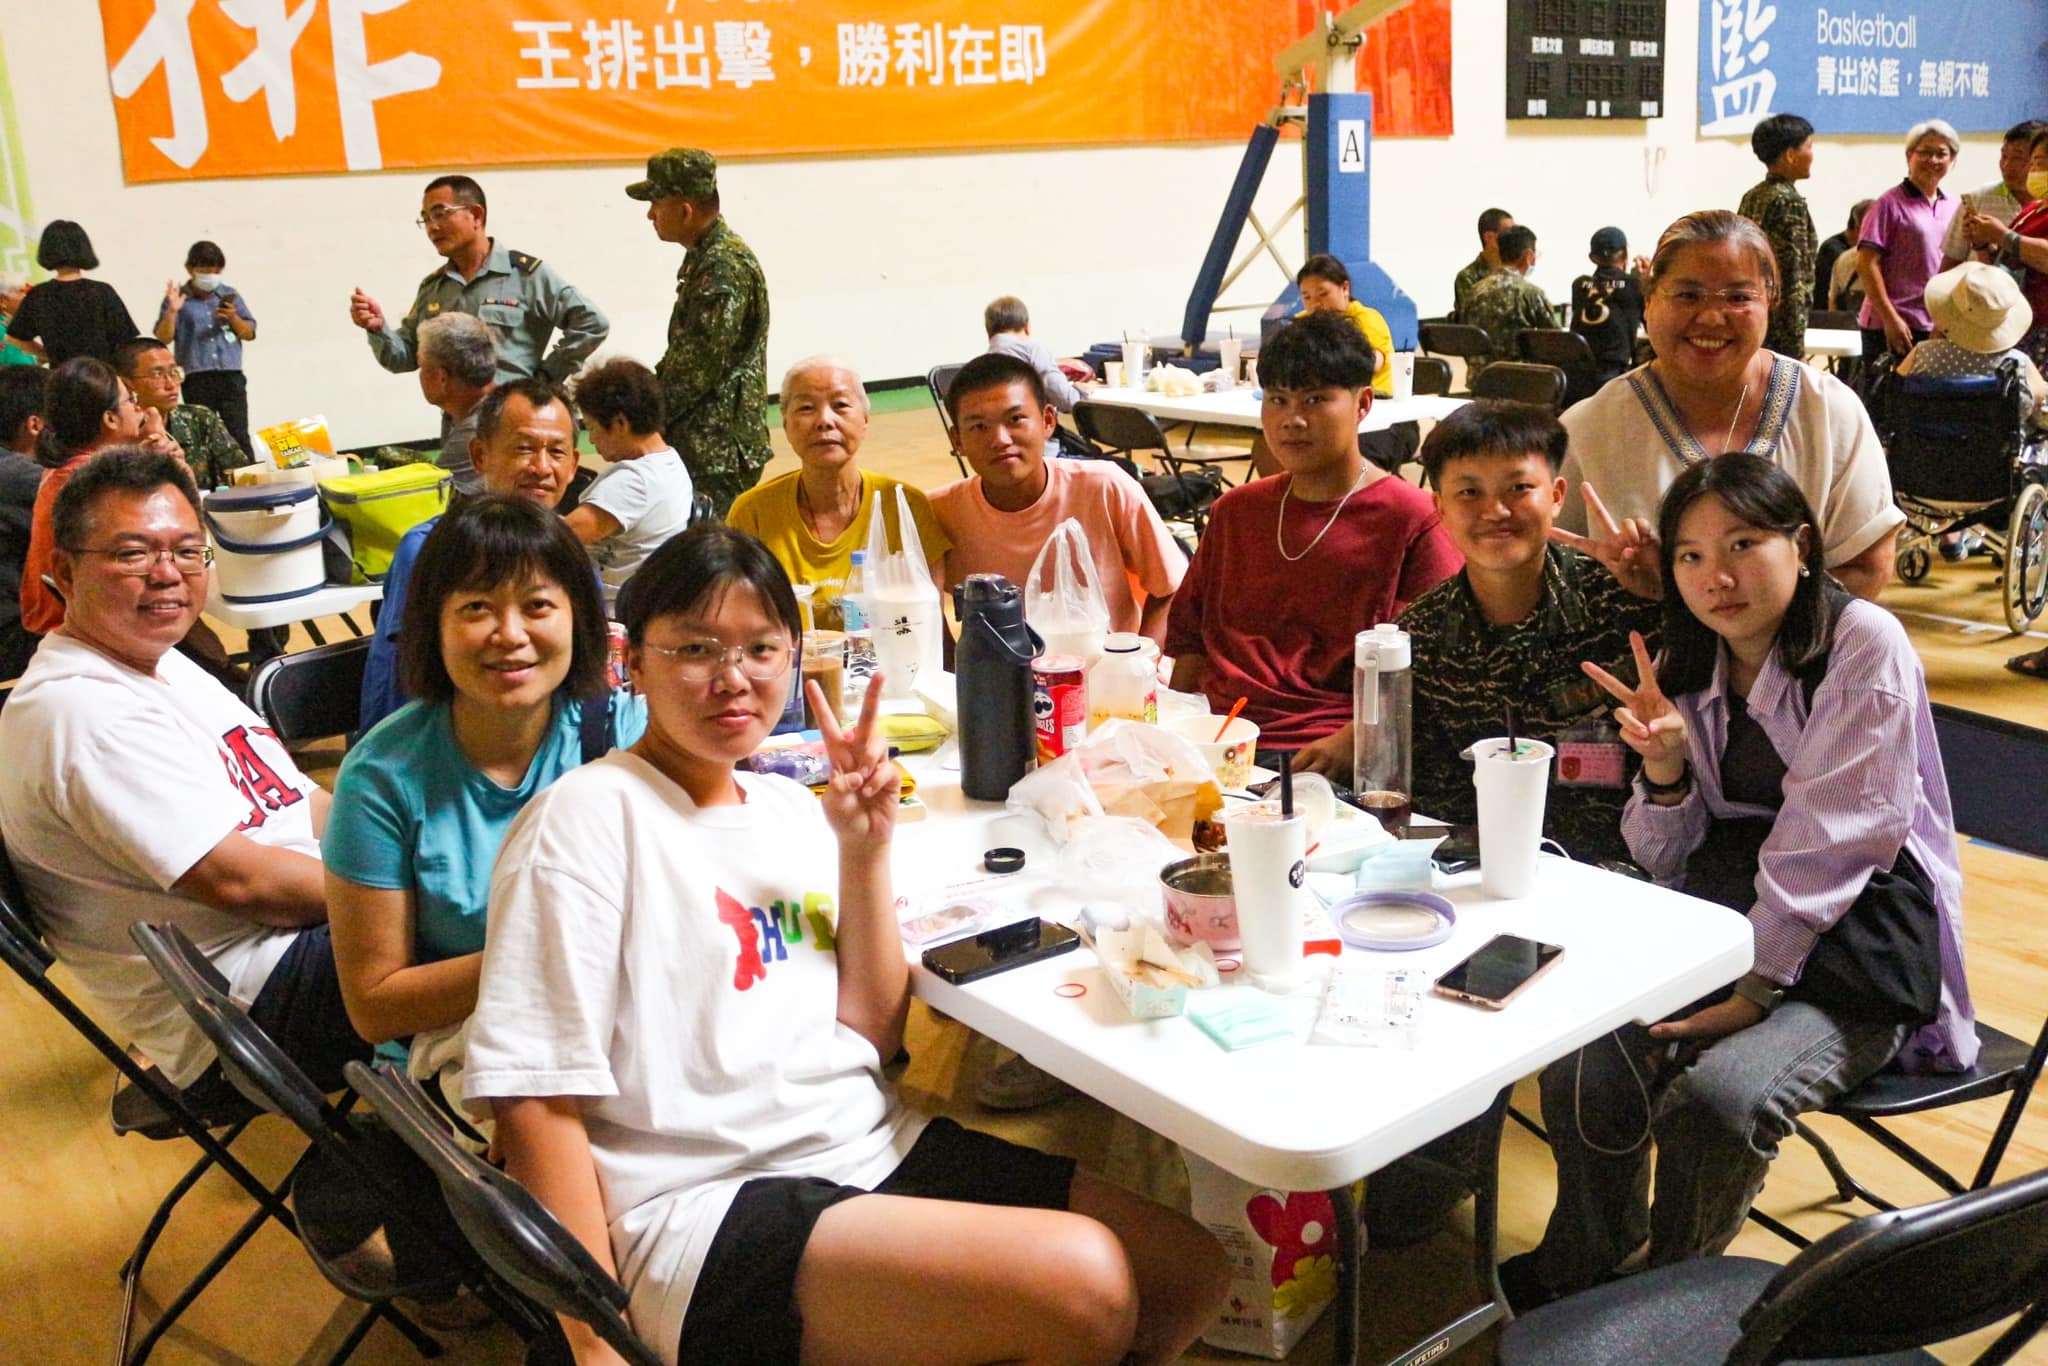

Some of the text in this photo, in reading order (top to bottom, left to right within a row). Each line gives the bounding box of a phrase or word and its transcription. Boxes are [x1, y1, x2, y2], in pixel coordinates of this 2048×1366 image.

[1817, 8, 1917, 48] Basketball
[512, 19, 1046, 90] 王排出擊，勝利在即
[1342, 129, 1360, 163] A
